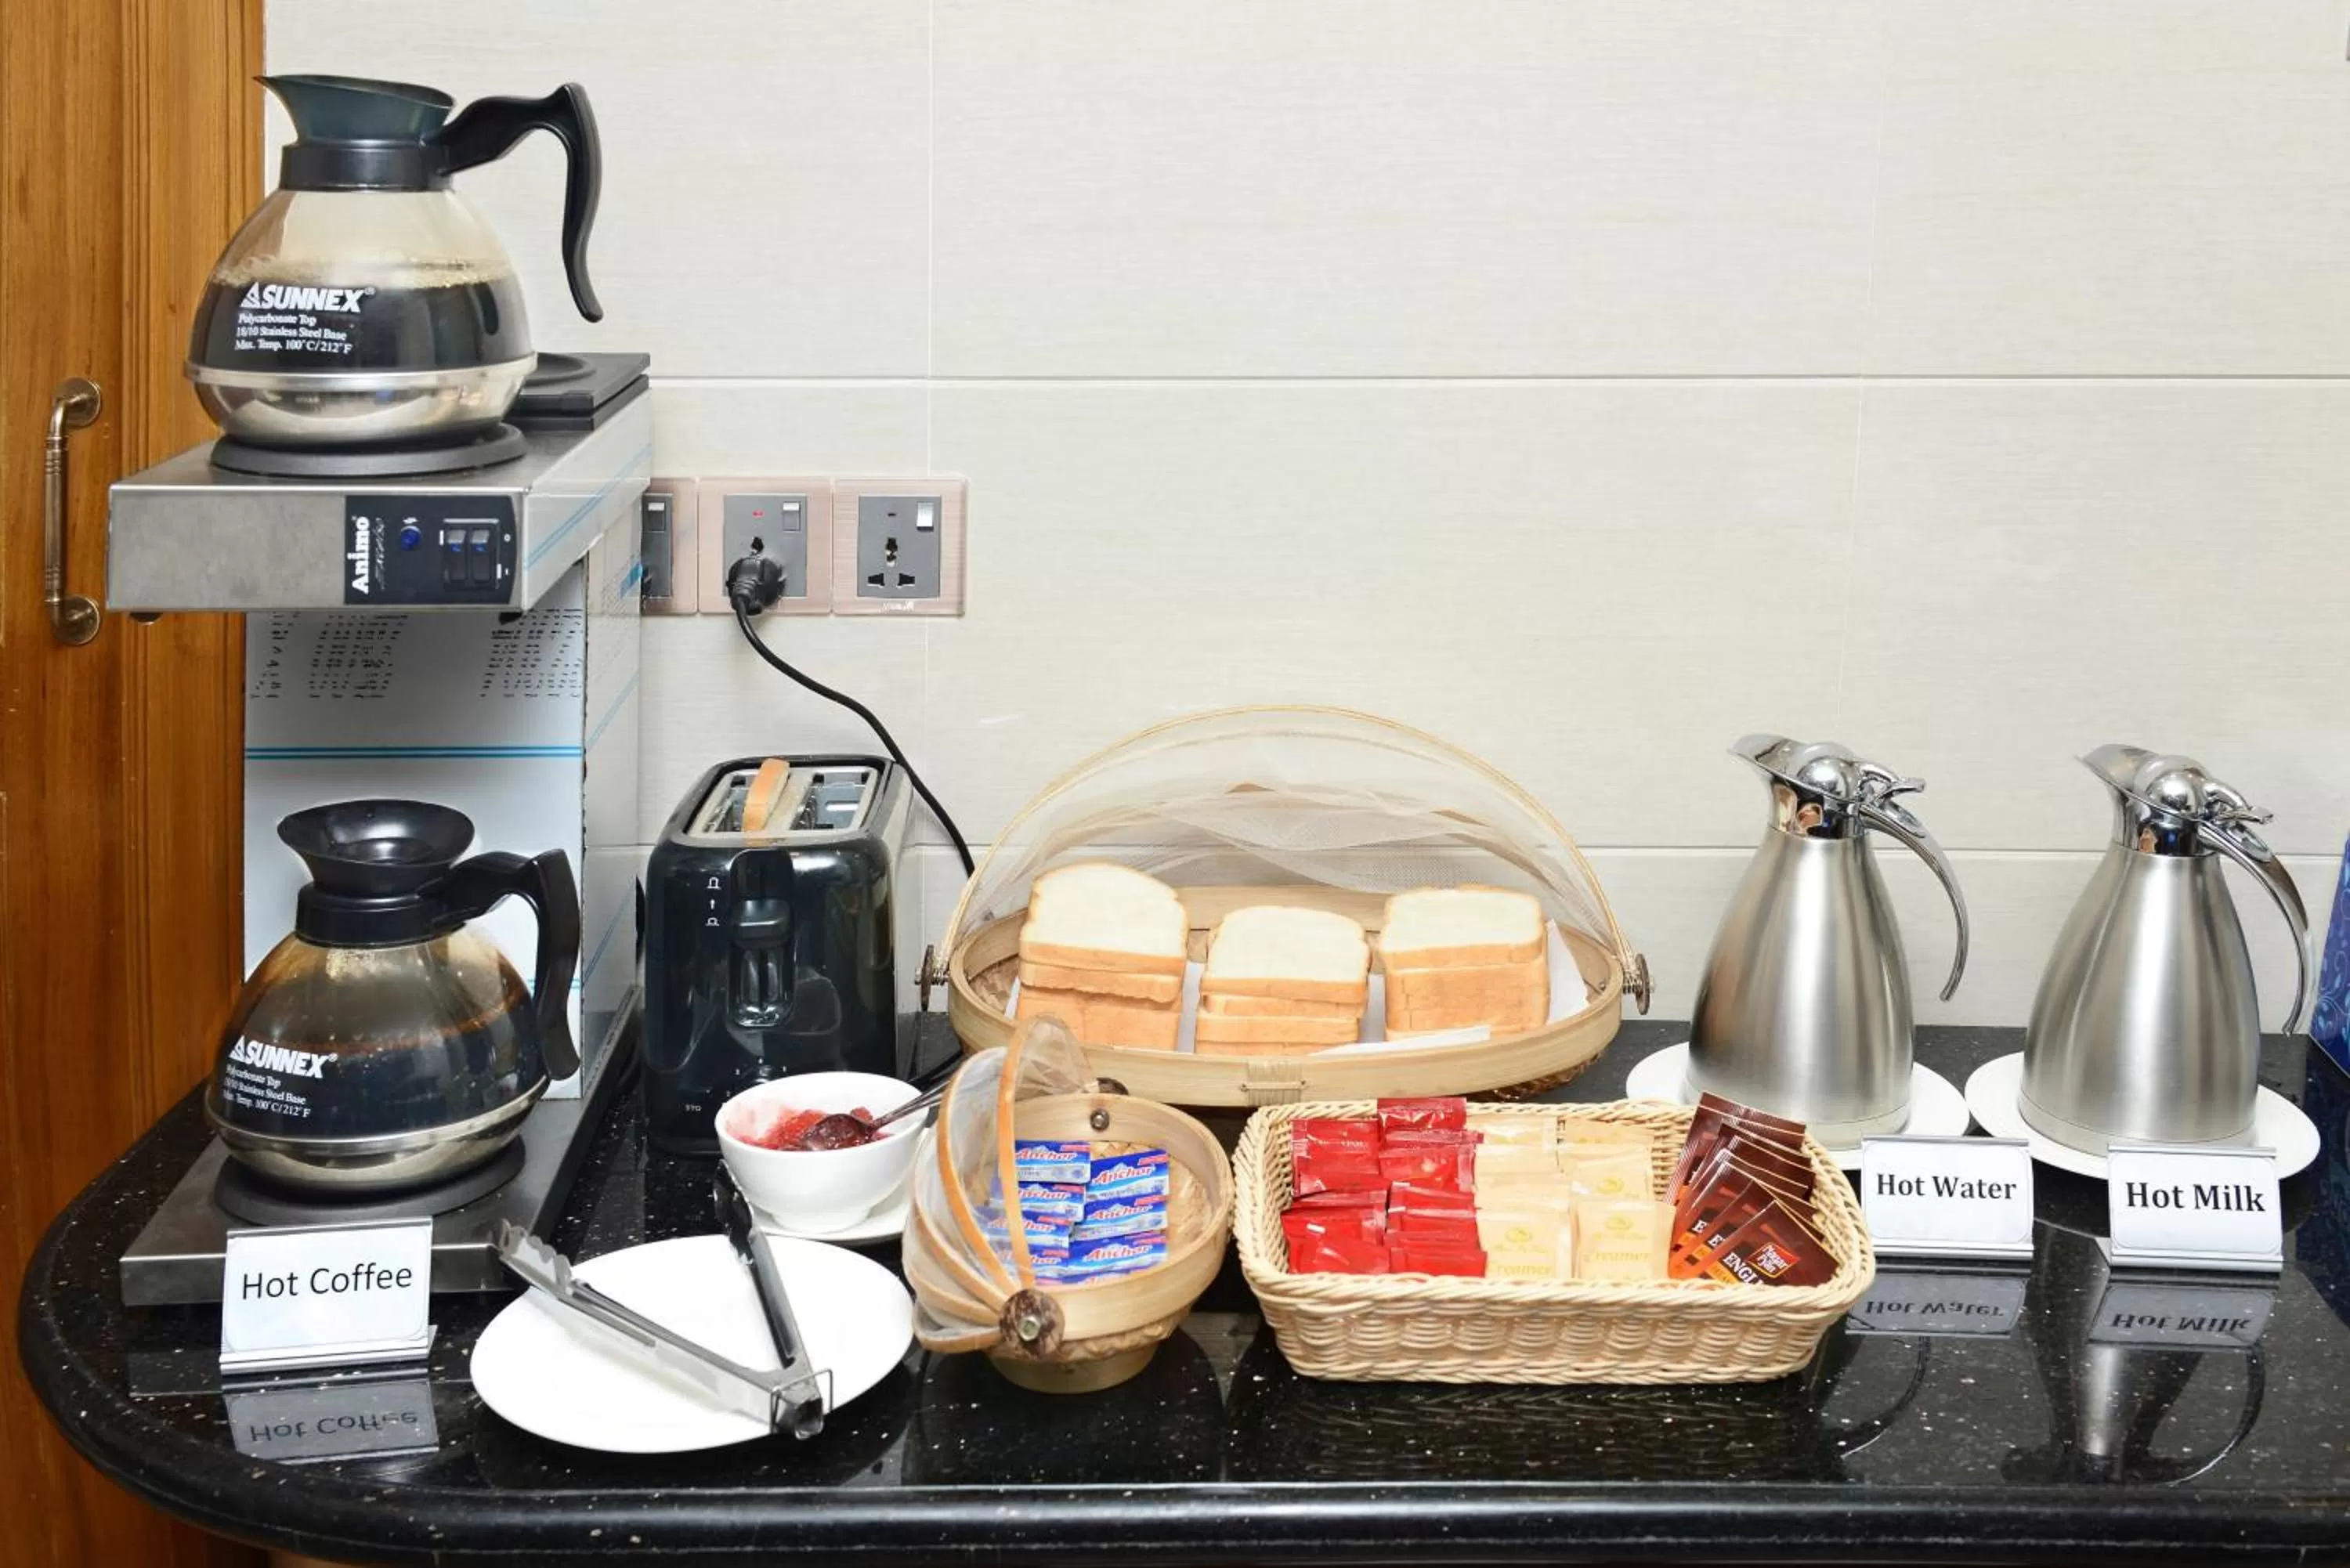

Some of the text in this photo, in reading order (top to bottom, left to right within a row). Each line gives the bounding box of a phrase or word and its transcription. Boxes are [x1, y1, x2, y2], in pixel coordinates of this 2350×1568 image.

[261, 284, 364, 313] SUNNEX
[299, 314, 316, 326] Top
[259, 326, 297, 337] Stainless
[298, 327, 322, 338] Steel
[324, 329, 347, 341] Base
[347, 516, 370, 594] Animo
[246, 1040, 328, 1078] SUNNEX
[1015, 1147, 1077, 1160] Anchor
[1091, 1165, 1155, 1184] Anchor
[1878, 1173, 2017, 1199] Hot Water
[2126, 1182, 2265, 1212] Hot Milk
[1087, 1206, 1152, 1219] Anchor
[1083, 1245, 1152, 1261] Anchor
[242, 1262, 413, 1299] Hot Coffee
